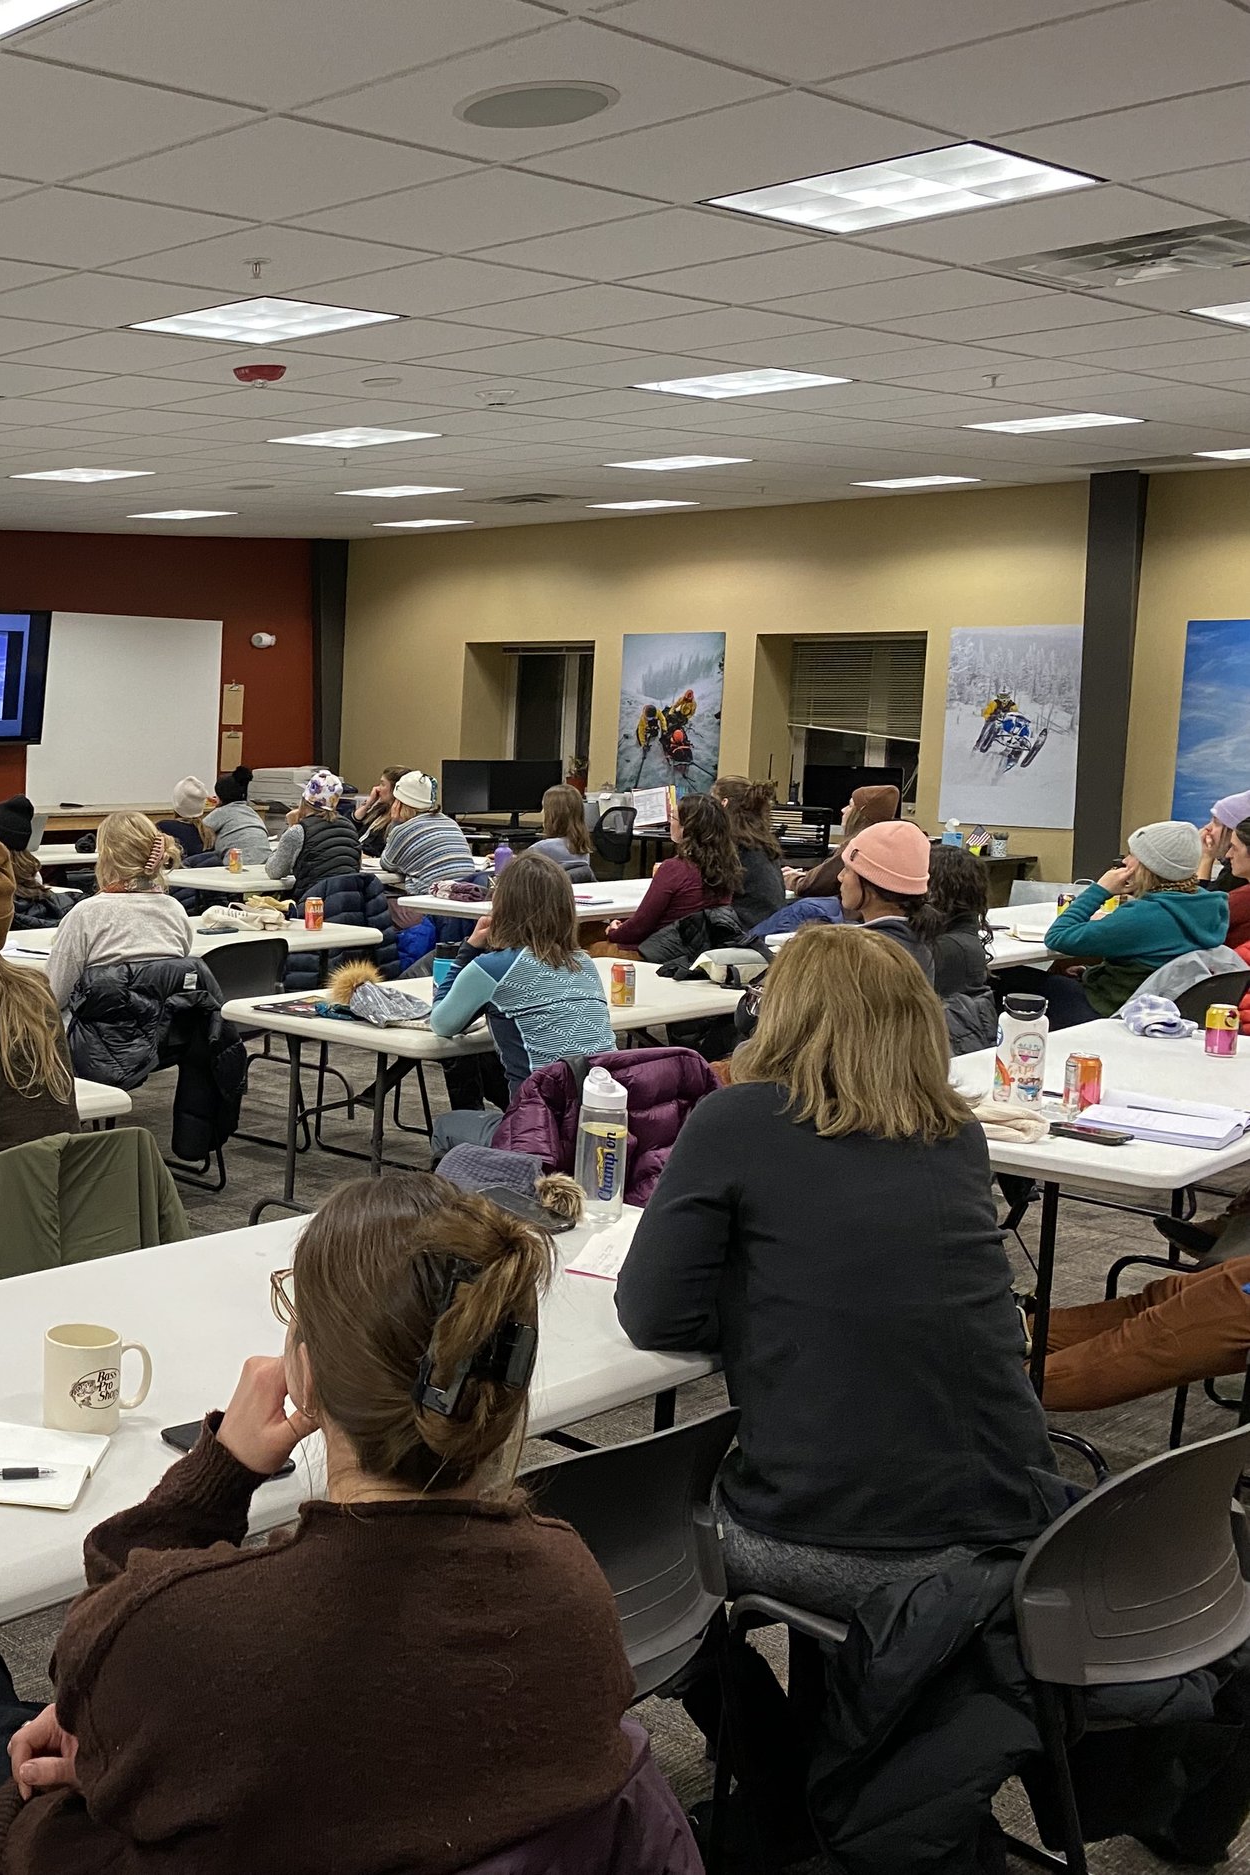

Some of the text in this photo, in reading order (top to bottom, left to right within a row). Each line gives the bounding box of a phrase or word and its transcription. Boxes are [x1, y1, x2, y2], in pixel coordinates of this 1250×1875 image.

[97, 1371, 117, 1383] Bass
[98, 1380, 114, 1392] Pro
[97, 1389, 119, 1402] Shops
